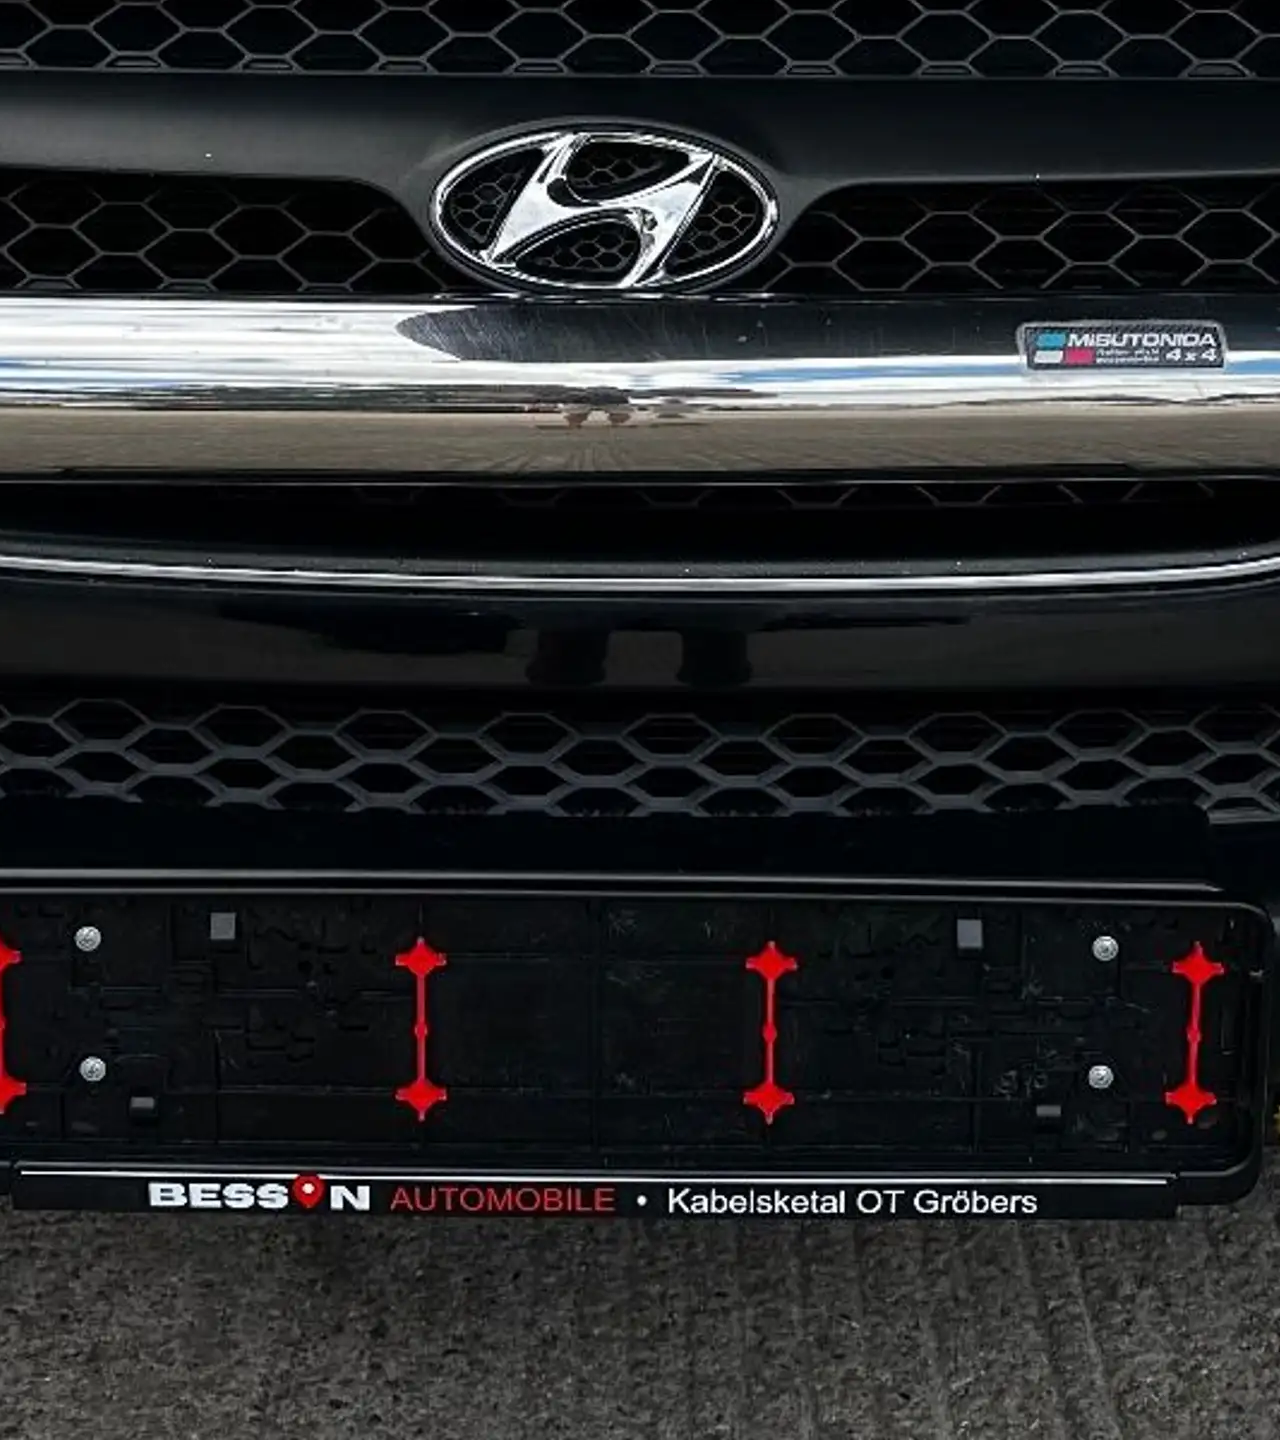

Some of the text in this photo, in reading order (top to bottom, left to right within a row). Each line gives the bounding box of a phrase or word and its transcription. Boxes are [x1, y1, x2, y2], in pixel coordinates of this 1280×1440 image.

[390, 1188, 616, 1212] AUTOMOBILE
[667, 1188, 846, 1214] Kabelsketal
[856, 1190, 906, 1214] OT
[913, 1189, 1039, 1214] Gröbers
